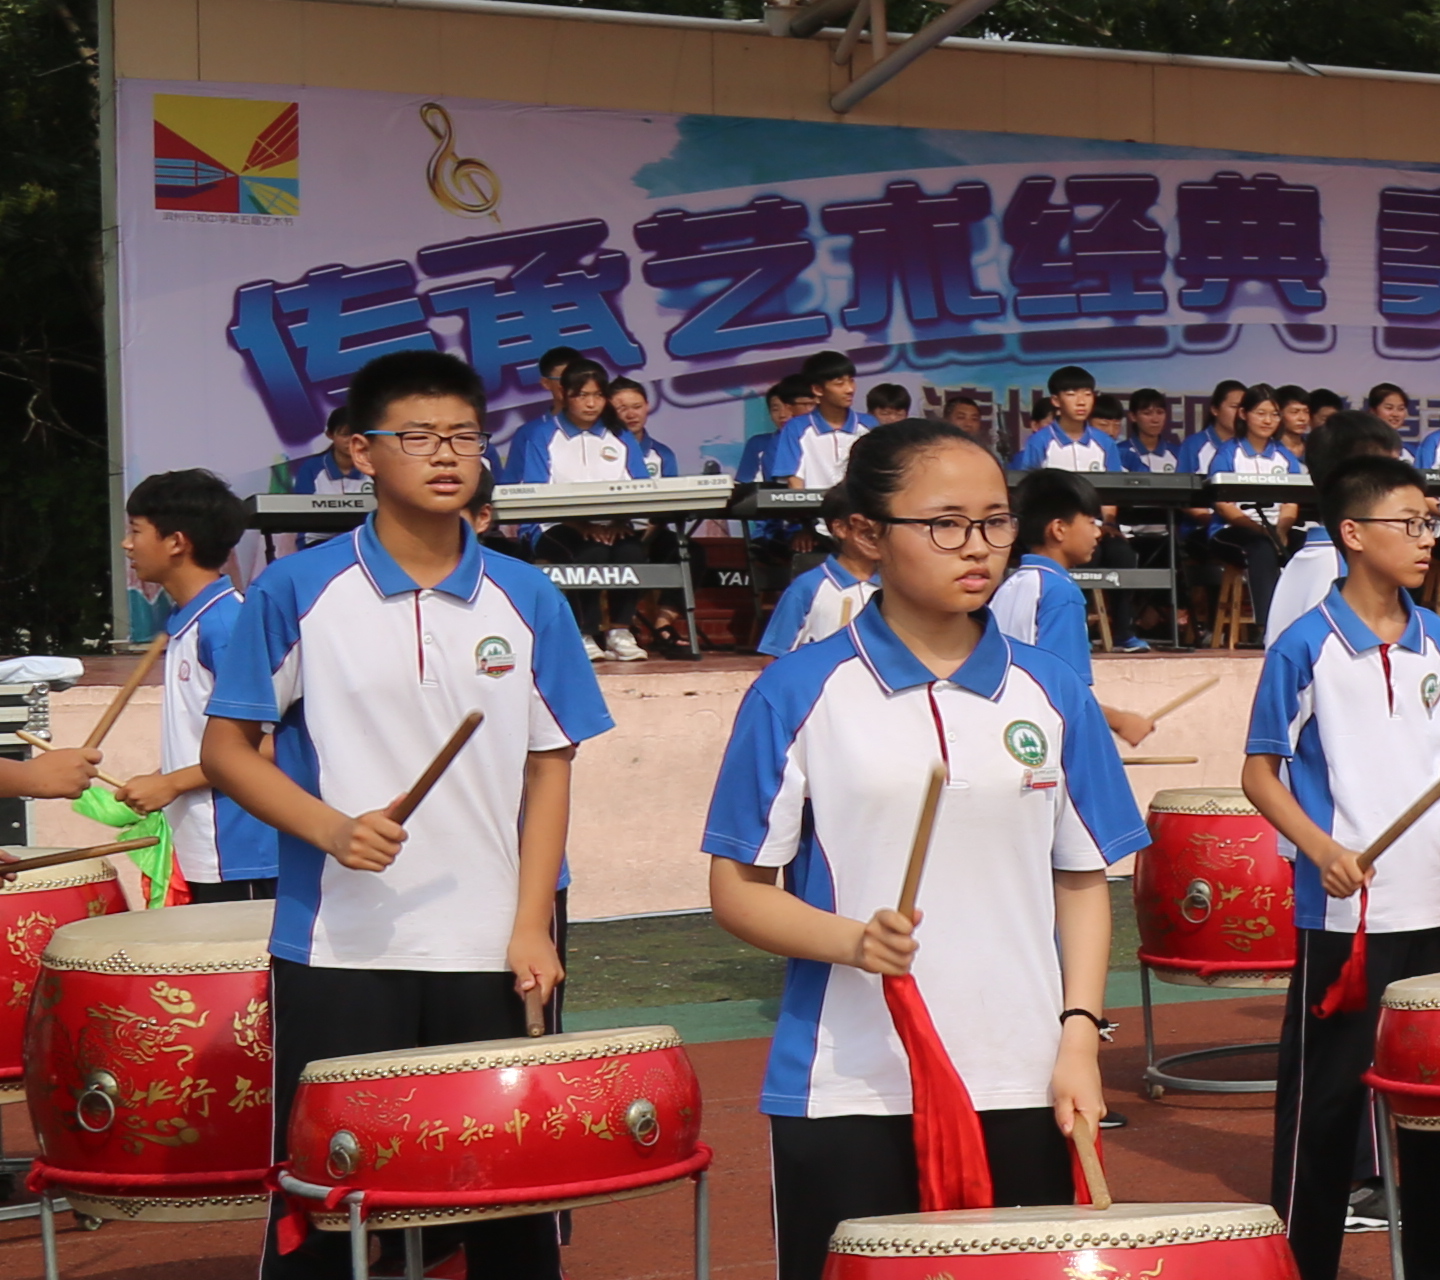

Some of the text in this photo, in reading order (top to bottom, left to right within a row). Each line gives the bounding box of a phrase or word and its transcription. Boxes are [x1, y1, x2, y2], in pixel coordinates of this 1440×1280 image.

[1238, 475, 1291, 483] MEDELI
[770, 493, 825, 502] MEDEL
[311, 499, 365, 509] MEIKE
[542, 566, 640, 585] AMAHA
[415, 1104, 569, 1153] 行知中学
